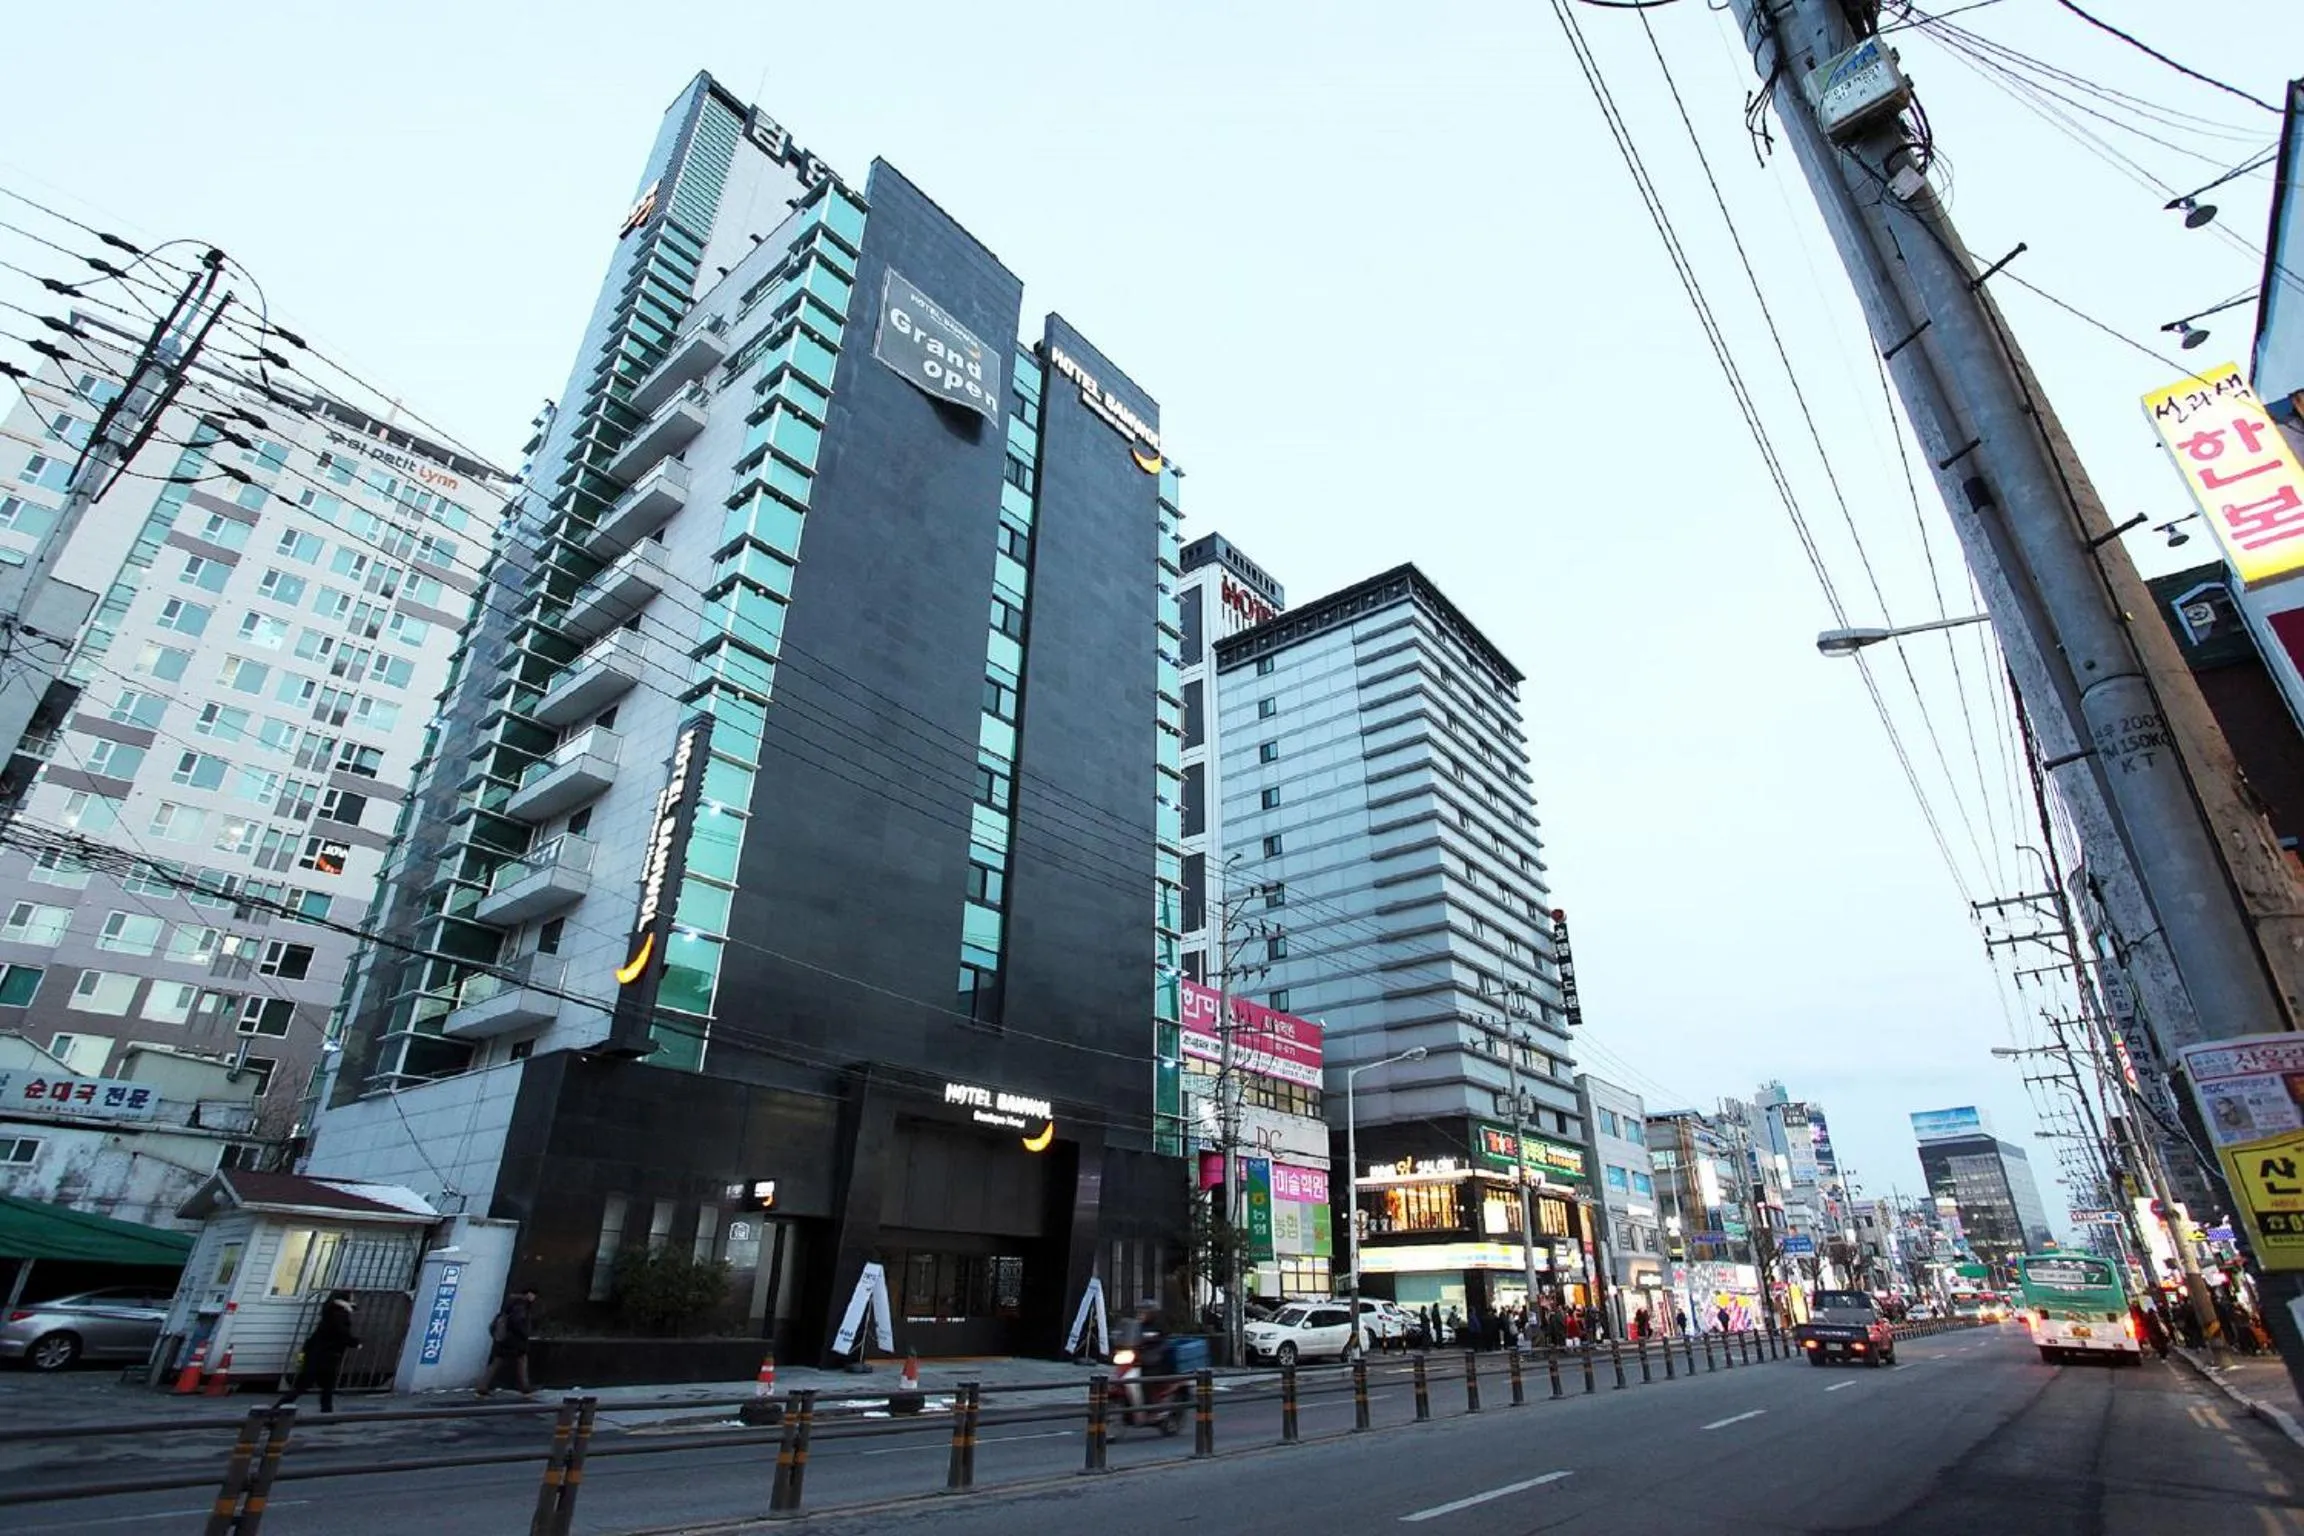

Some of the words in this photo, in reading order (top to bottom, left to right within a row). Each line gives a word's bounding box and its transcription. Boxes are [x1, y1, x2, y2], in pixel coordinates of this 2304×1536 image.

[889, 307, 983, 381] Grand
[922, 359, 998, 413] open
[1051, 345, 1103, 401] HOTEL
[664, 728, 696, 815] HOTEL
[23, 1077, 98, 1105] 순대국
[103, 1085, 151, 1110] 전문
[944, 1082, 993, 1107] HOTEL
[1275, 1169, 1324, 1199] 미술학원
[2086, 1272, 2100, 1283] 7
[424, 1297, 451, 1359] 주차장
